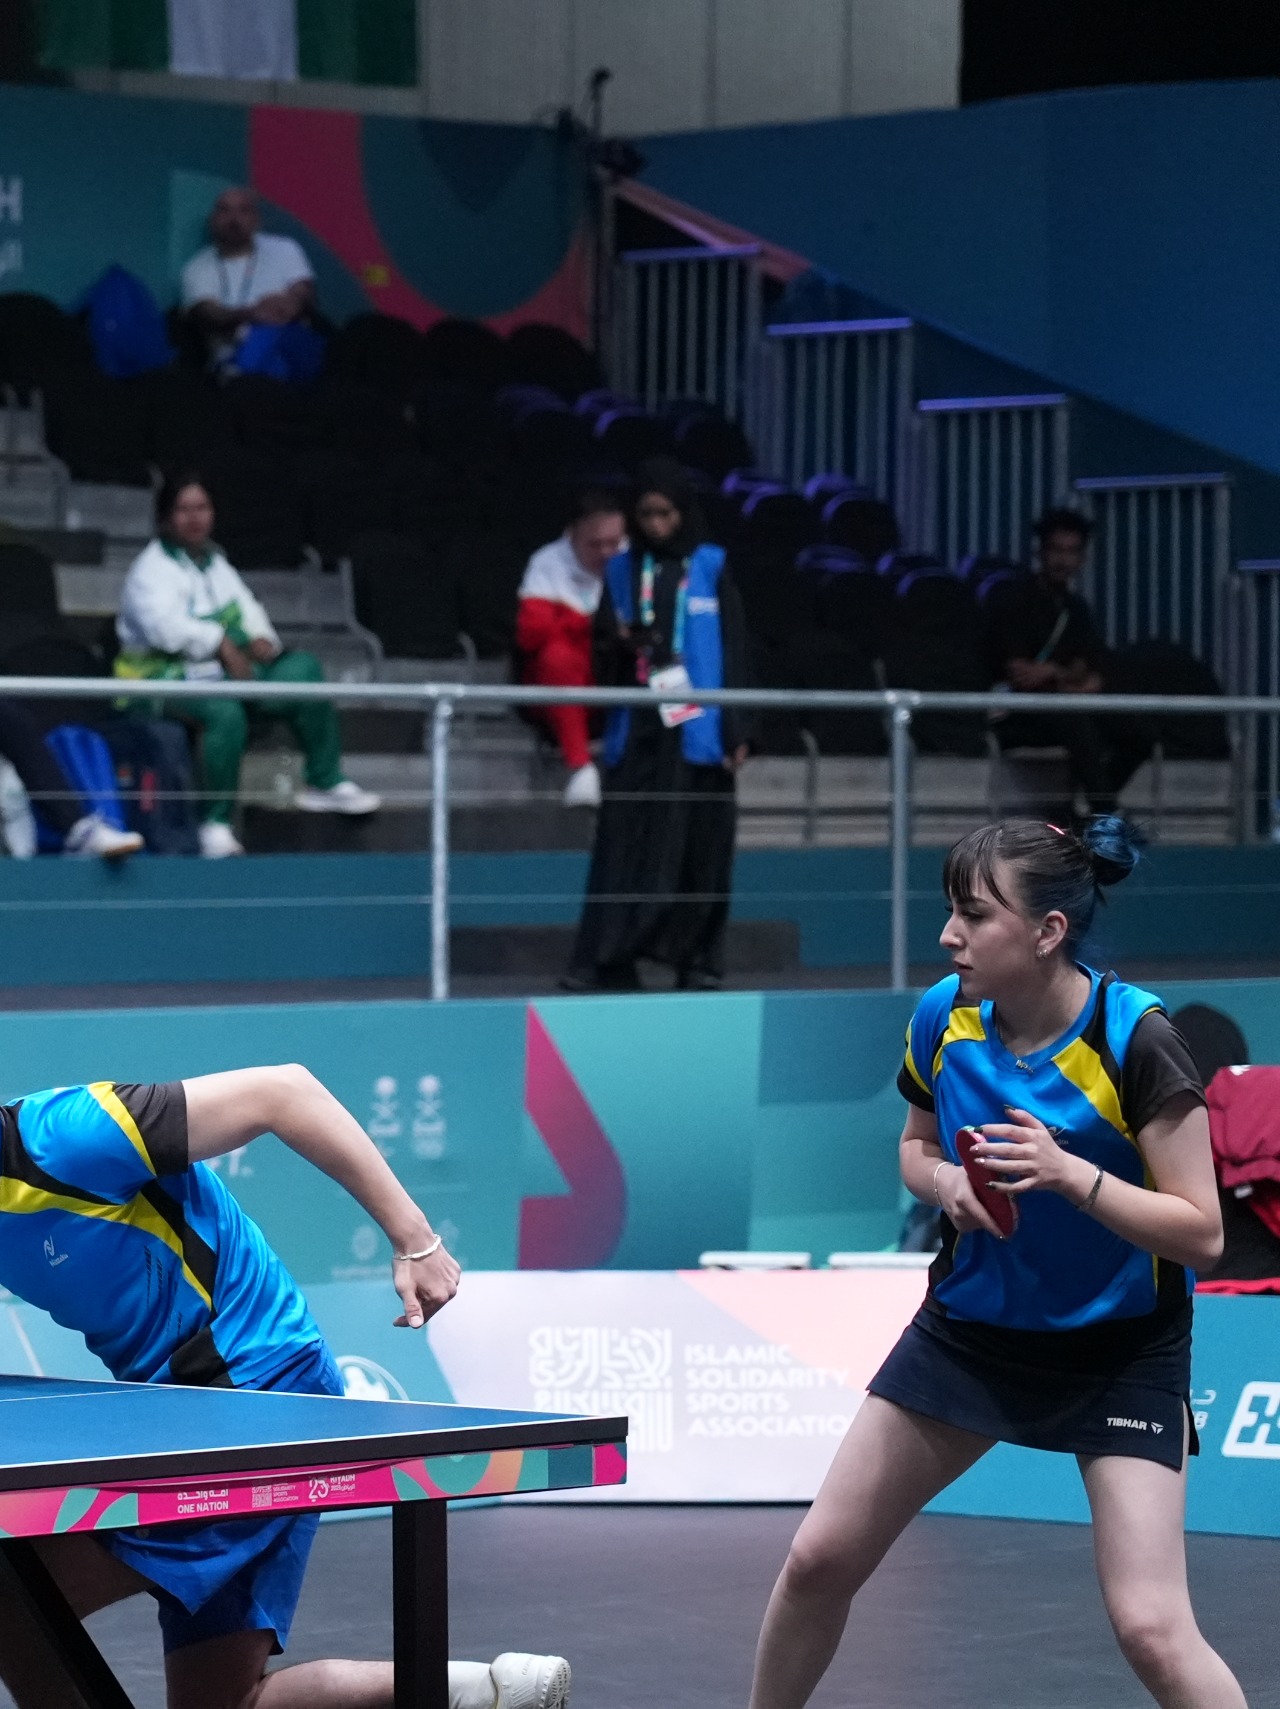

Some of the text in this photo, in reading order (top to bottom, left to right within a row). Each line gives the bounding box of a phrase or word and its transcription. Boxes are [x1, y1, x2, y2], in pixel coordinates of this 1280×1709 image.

[684, 1343, 792, 1366] ISLAMIC
[685, 1367, 850, 1391] SOLIDARITY
[685, 1391, 791, 1414] SPORTS
[688, 1415, 852, 1438] ASSOCIATIO
[1106, 1417, 1148, 1431] TIBHAR
[177, 1500, 229, 1514] ONE NATION
